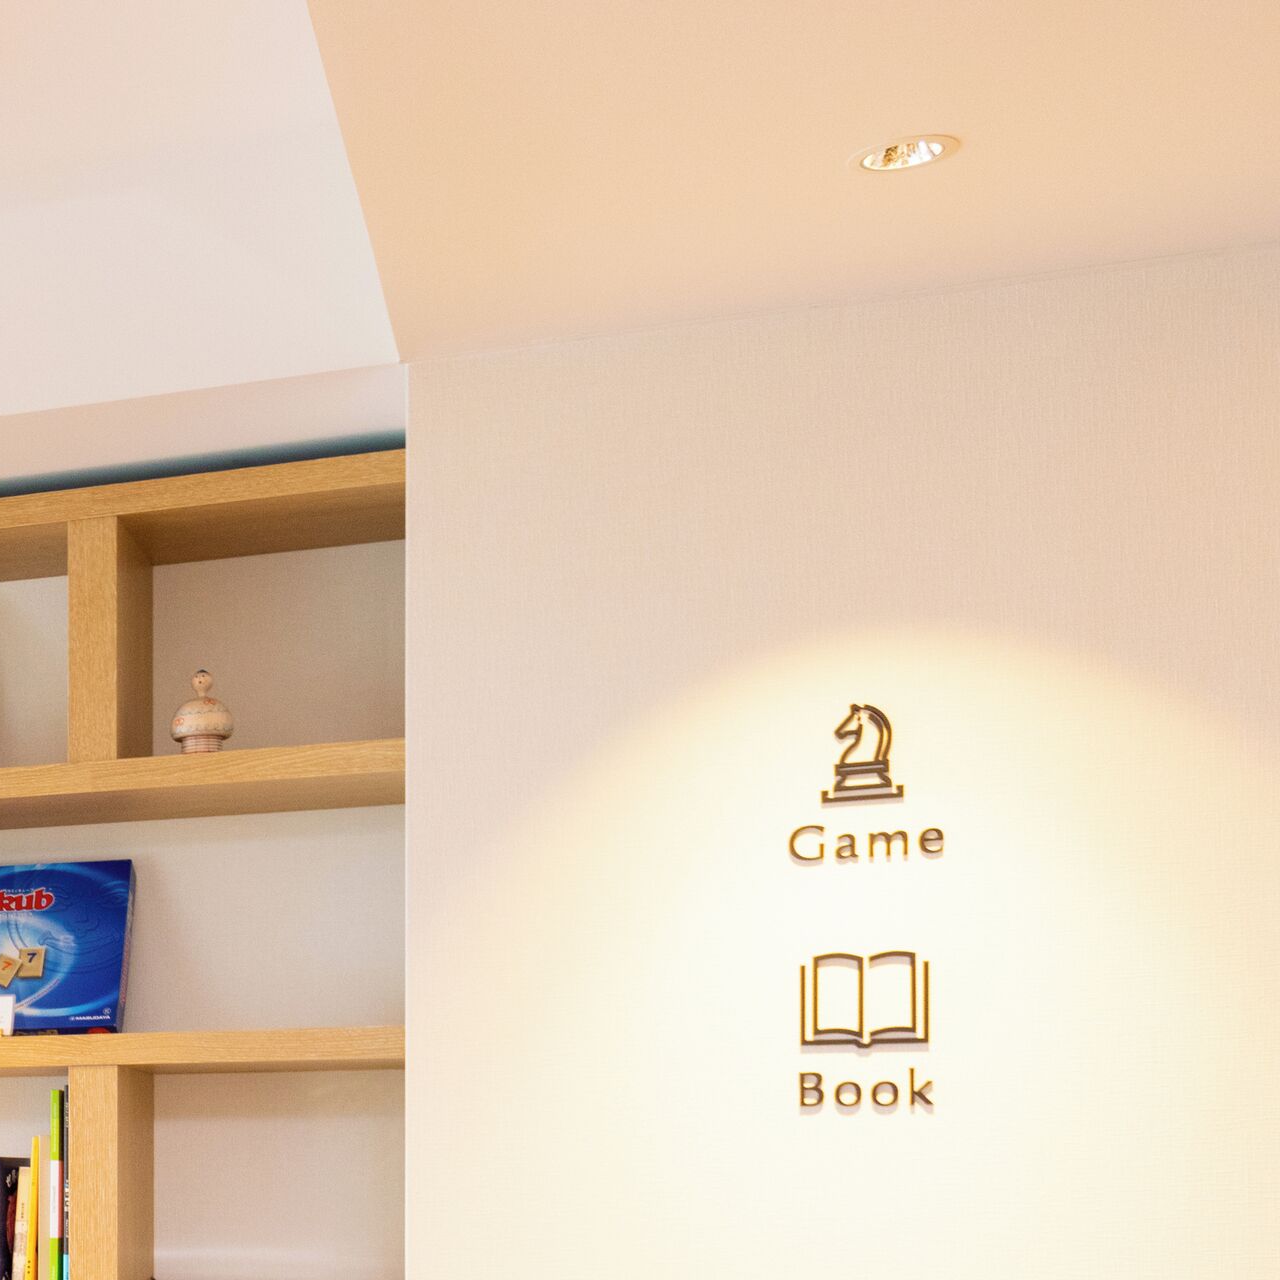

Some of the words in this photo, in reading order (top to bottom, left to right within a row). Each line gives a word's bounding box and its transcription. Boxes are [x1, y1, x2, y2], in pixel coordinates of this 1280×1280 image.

[789, 824, 945, 862] Game
[1, 961, 13, 971] 7
[27, 952, 37, 963] 7
[799, 1068, 935, 1109] Book
